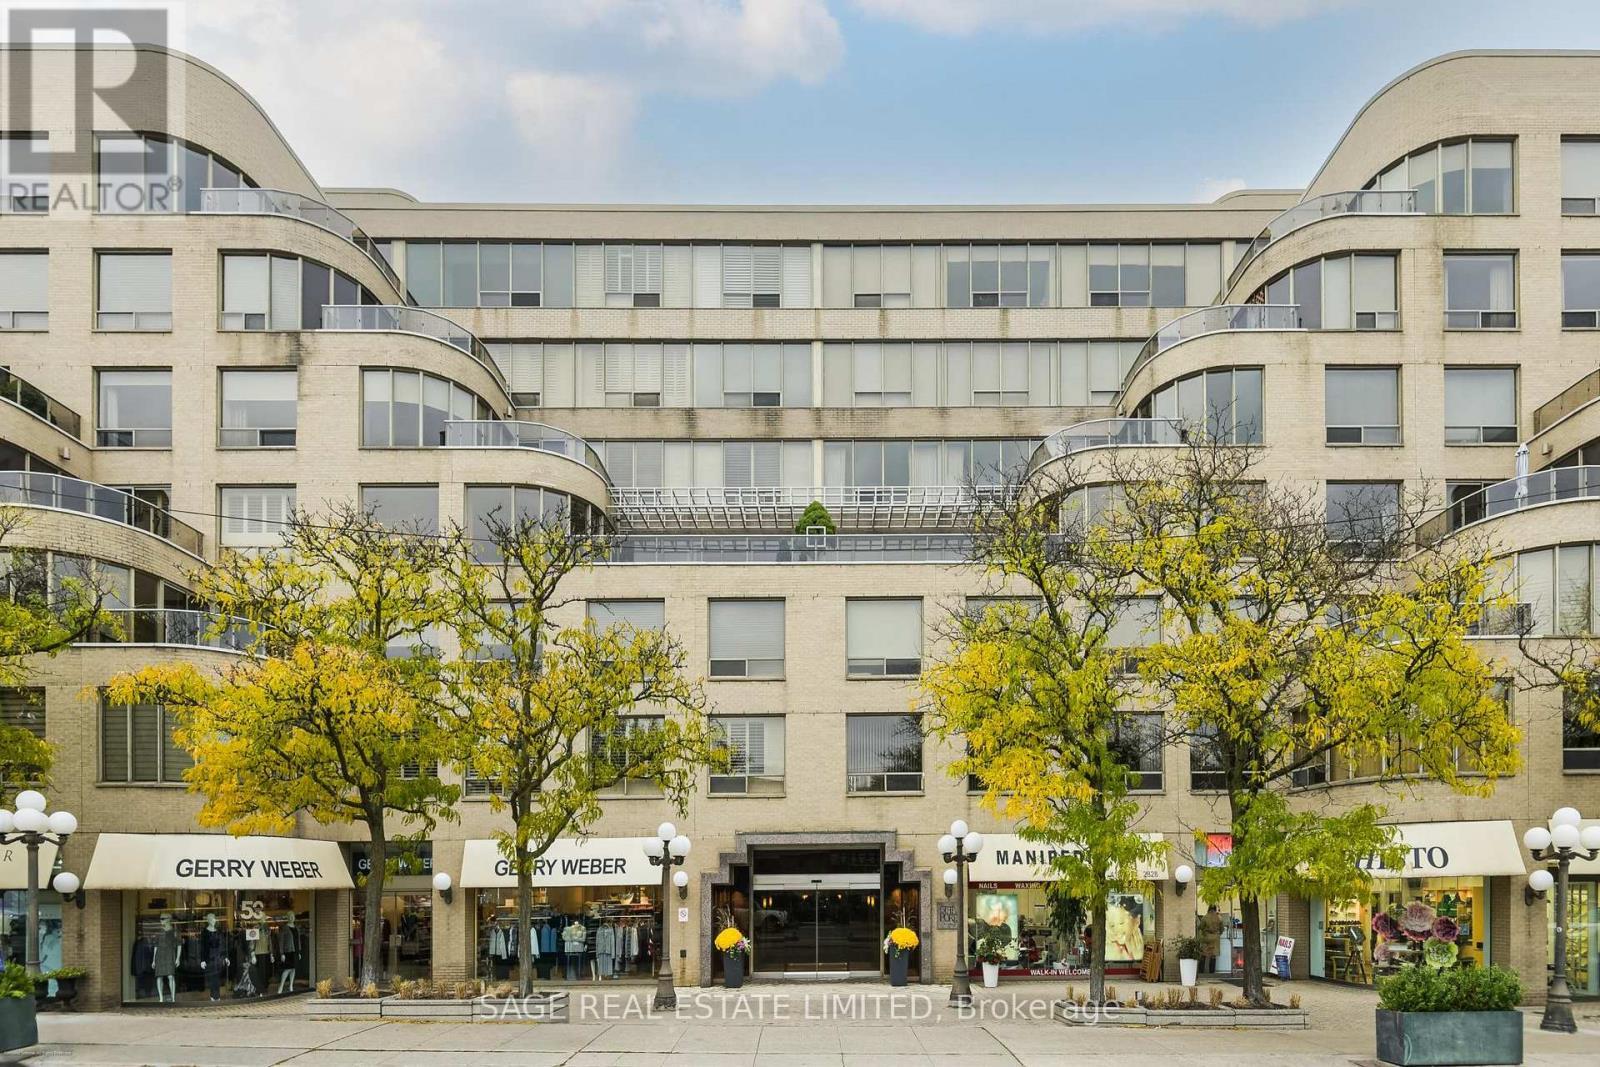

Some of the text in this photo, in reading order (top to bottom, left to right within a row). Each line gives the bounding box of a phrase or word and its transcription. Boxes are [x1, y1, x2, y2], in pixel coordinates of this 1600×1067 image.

[176, 858, 323, 878] GERRY WEBER
[494, 858, 627, 876] GERY WEBER
[1030, 968, 1091, 976] WALK-IN WELCOME
